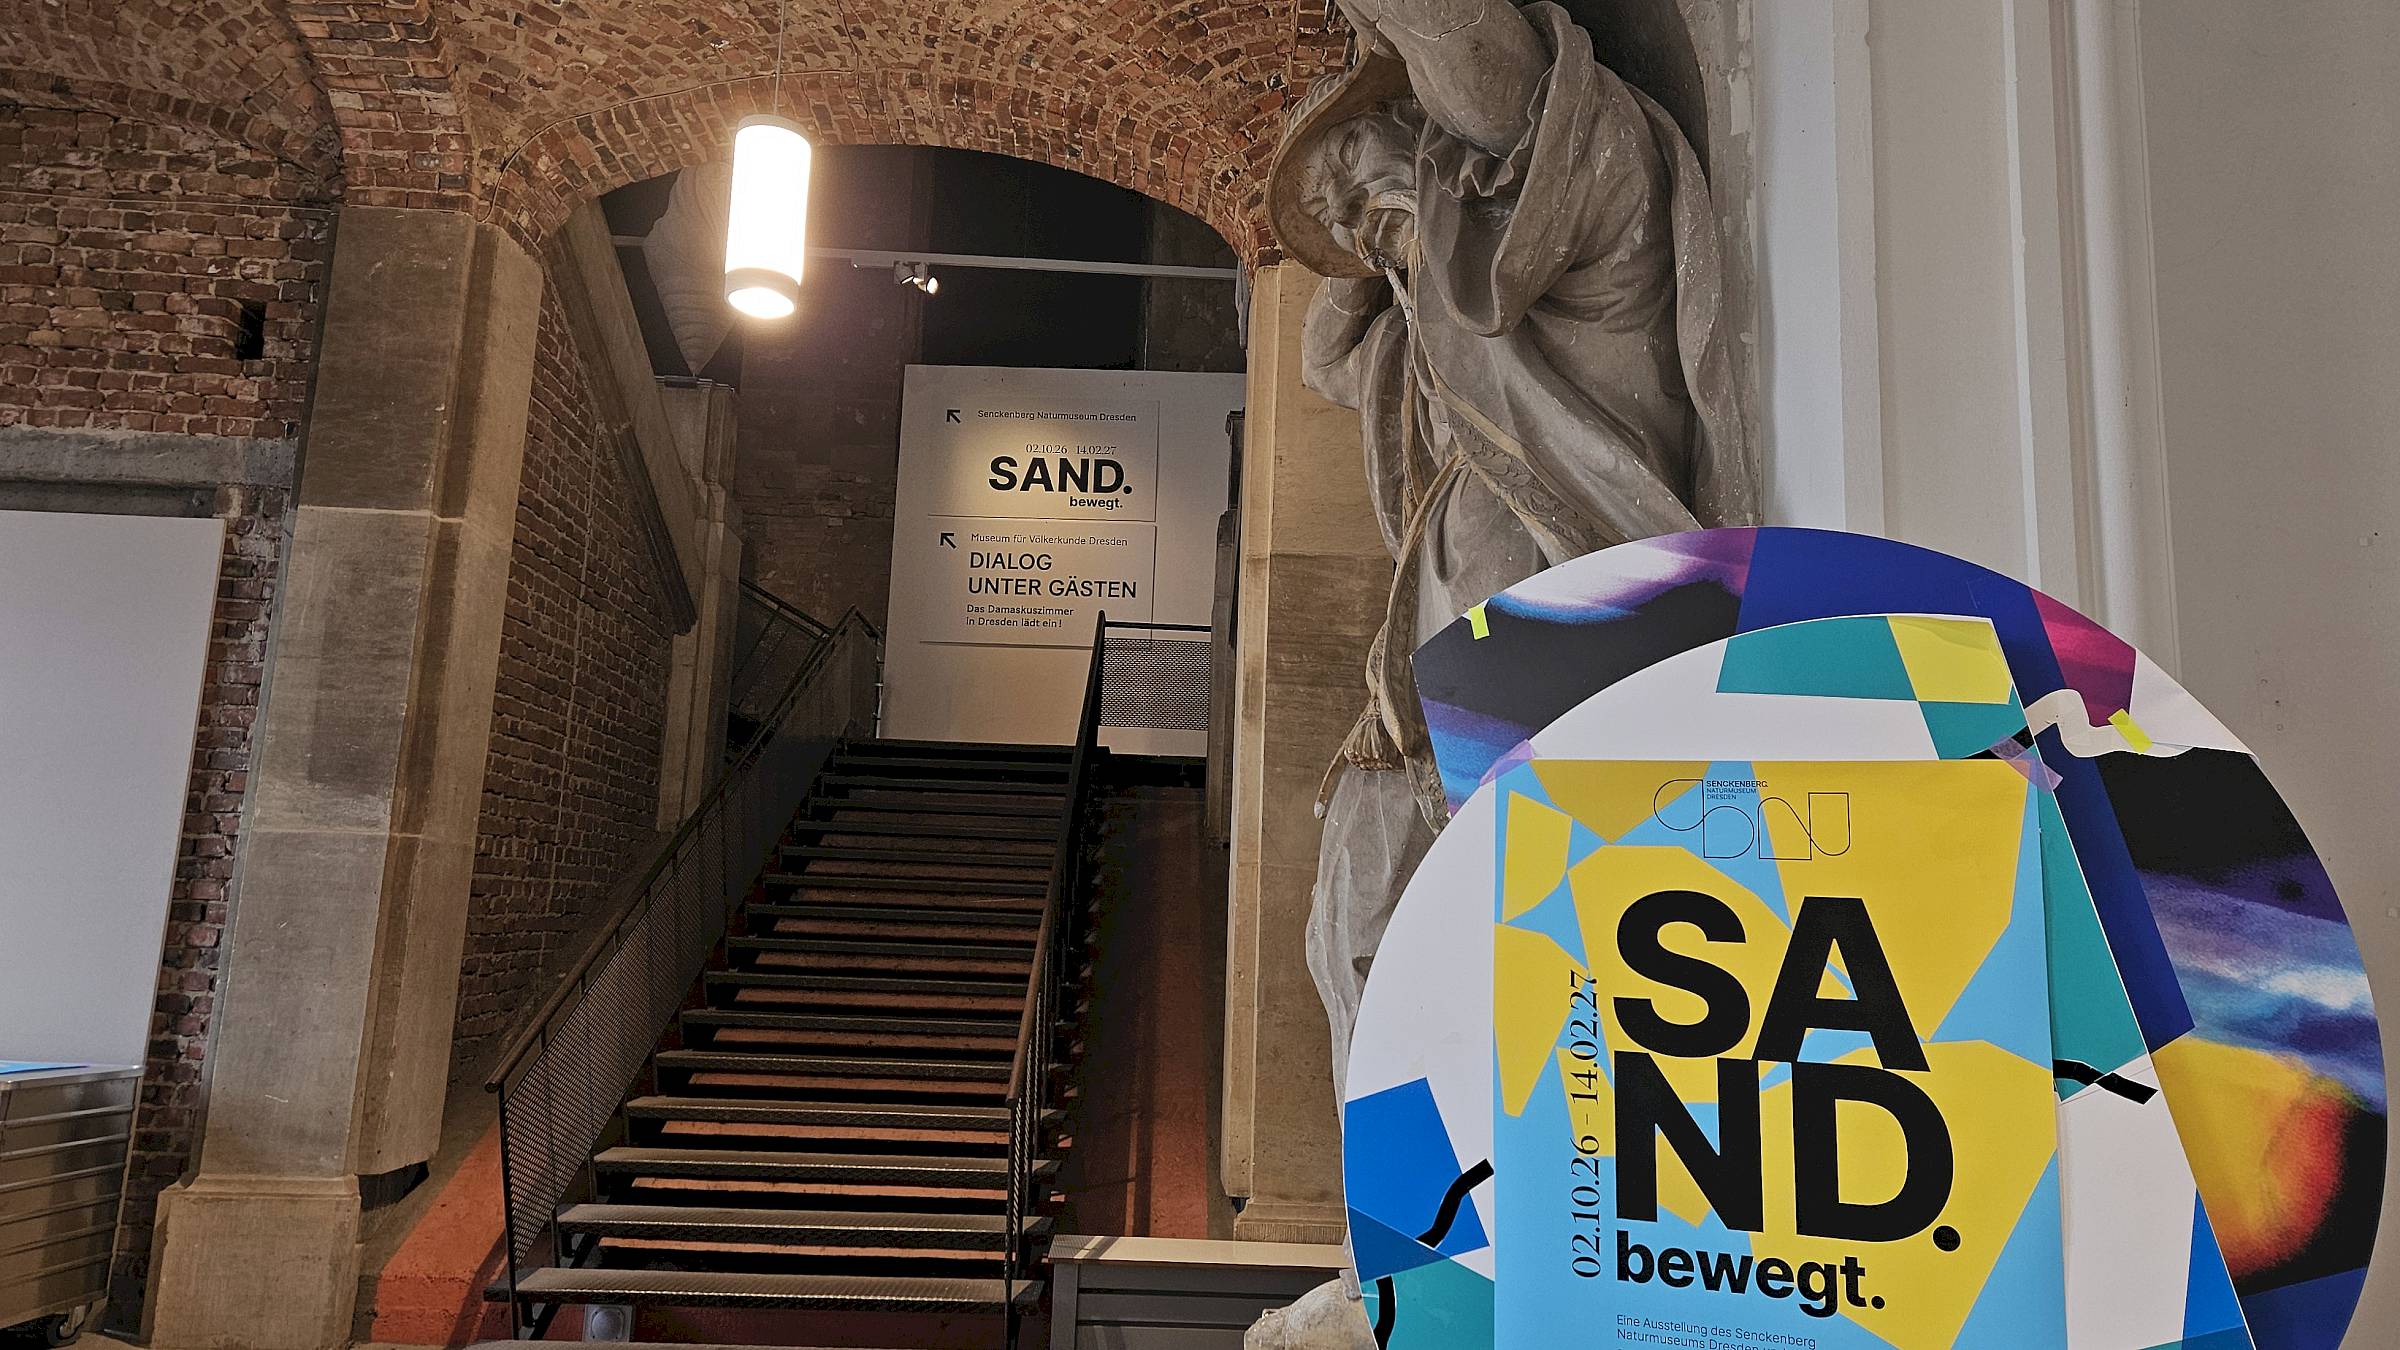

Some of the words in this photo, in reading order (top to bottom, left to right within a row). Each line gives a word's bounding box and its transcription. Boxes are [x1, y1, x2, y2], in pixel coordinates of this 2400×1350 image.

[977, 409, 1035, 421] Senckenberg
[1037, 411, 1098, 422] Naturmuseum
[1099, 412, 1137, 422] Dresden
[1025, 443, 1068, 455] 02.10.26
[1076, 445, 1117, 456] 14.02.27
[988, 456, 1133, 495] SAND.
[1069, 495, 1123, 510] bewegt.
[971, 533, 1010, 544] Museum
[1012, 533, 1027, 544] für
[1029, 534, 1086, 546] Völkerkunde
[1089, 536, 1128, 547] Dresden
[970, 551, 1053, 572] DIALOG
[968, 577, 1042, 596] UNTER
[1048, 575, 1137, 599] GÄSTEN
[967, 604, 985, 614] Das
[988, 604, 1074, 617] Damaskuszimmer
[966, 616, 976, 626] in
[978, 617, 1018, 627] Dresden
[1021, 617, 1040, 628] lädt
[1613, 889, 1932, 1073] SA
[1569, 969, 1600, 1105] 14.02.27
[1613, 1050, 1962, 1252] ND.
[1570, 1137, 1602, 1278] 02.10.26
[1616, 1229, 1886, 1318] bewegt.
[1616, 1314, 1640, 1327] Eine
[1643, 1317, 1708, 1337] Ausstellung
[1710, 1326, 1732, 1338] des
[1735, 1328, 1816, 1350] Senckenberg
[1617, 1328, 1705, 1349] Naturmuseums
